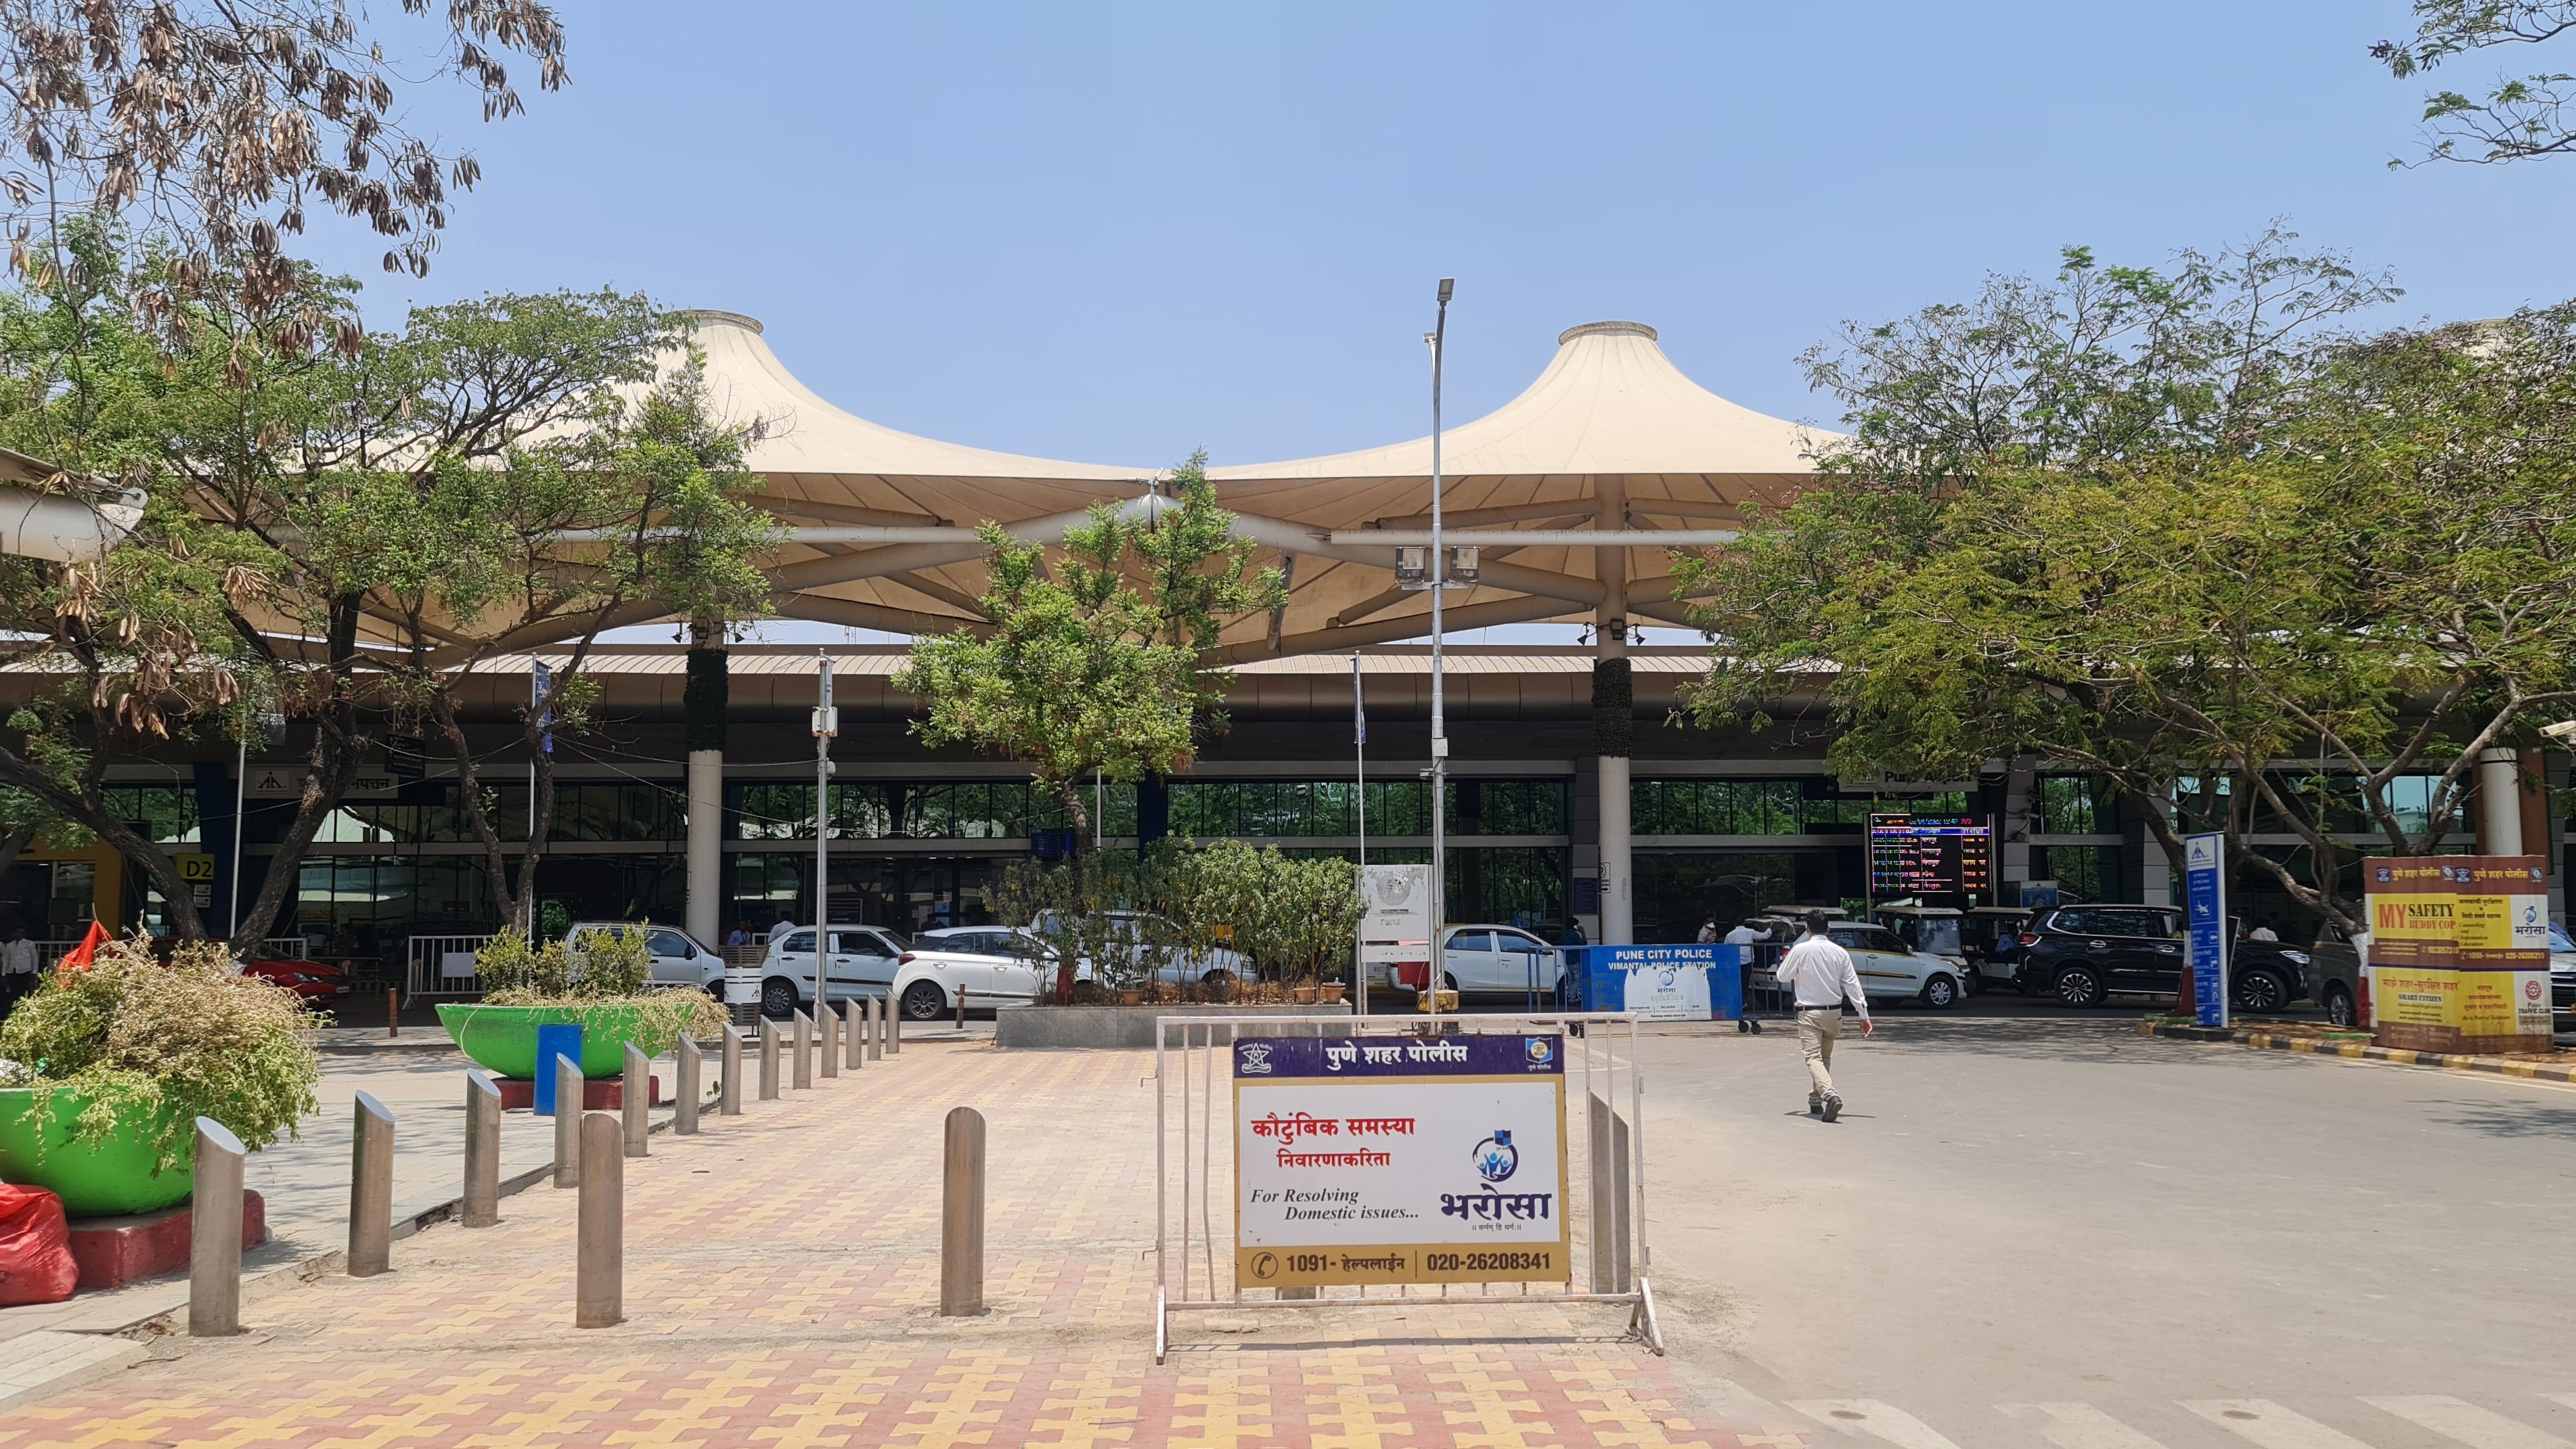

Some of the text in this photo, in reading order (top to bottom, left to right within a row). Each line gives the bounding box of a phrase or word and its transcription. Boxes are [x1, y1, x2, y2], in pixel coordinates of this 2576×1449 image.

[187, 861, 212, 877] D2
[2392, 866, 2440, 880] पुणे शहर पोलीस
[2474, 868, 2528, 881] पुणे शहर पोलीस
[2378, 904, 2454, 928] MY SAFETY
[2410, 920, 2456, 929] BUDDY COP
[2515, 922, 2546, 935] भरोसा
[1616, 949, 1712, 960] PUNE CITY POLICE
[1682, 961, 1716, 969] STATION
[2443, 982, 2459, 991] शहर
[1326, 1040, 1467, 1071] पुणे शहर पोलीस
[1250, 1111, 1415, 1145] कौटुंबिक समस्या
[1275, 1147, 1391, 1168] निवारणाकरिता
[1250, 1188, 1360, 1205] For Resolving
[1440, 1183, 1552, 1220] भरोसा
[1284, 1205, 1419, 1220] Domestic issues...
[1286, 1252, 1550, 1272] 1091- हेल्पलाईन 020-26208341
